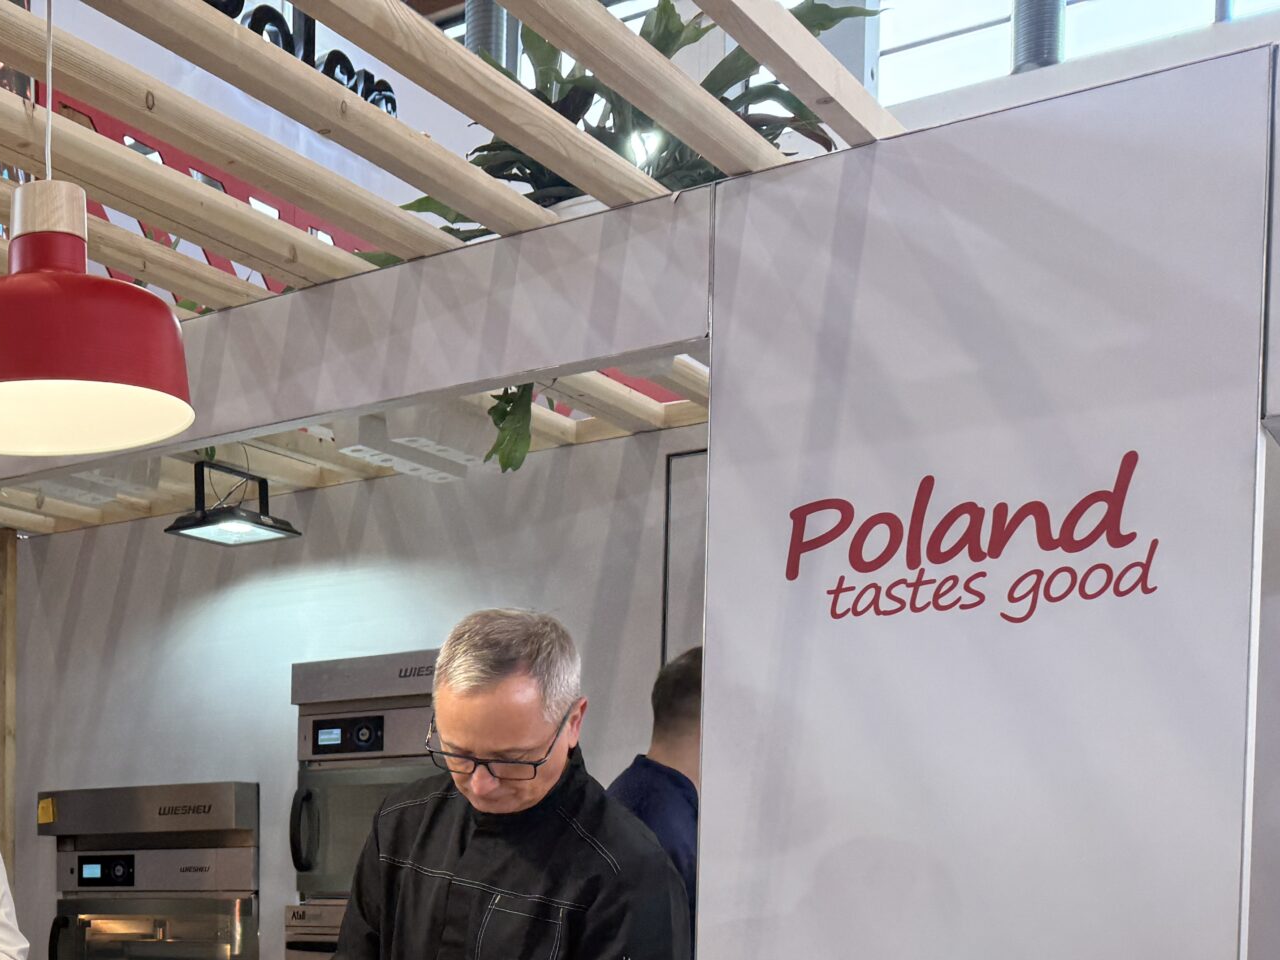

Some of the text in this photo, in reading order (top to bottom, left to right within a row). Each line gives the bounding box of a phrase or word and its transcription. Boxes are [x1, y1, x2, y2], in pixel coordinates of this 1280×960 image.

[785, 450, 1139, 581] Poland
[826, 538, 1160, 624] tastes good
[398, 665, 433, 679] WIES
[158, 804, 212, 816] WIESHEU
